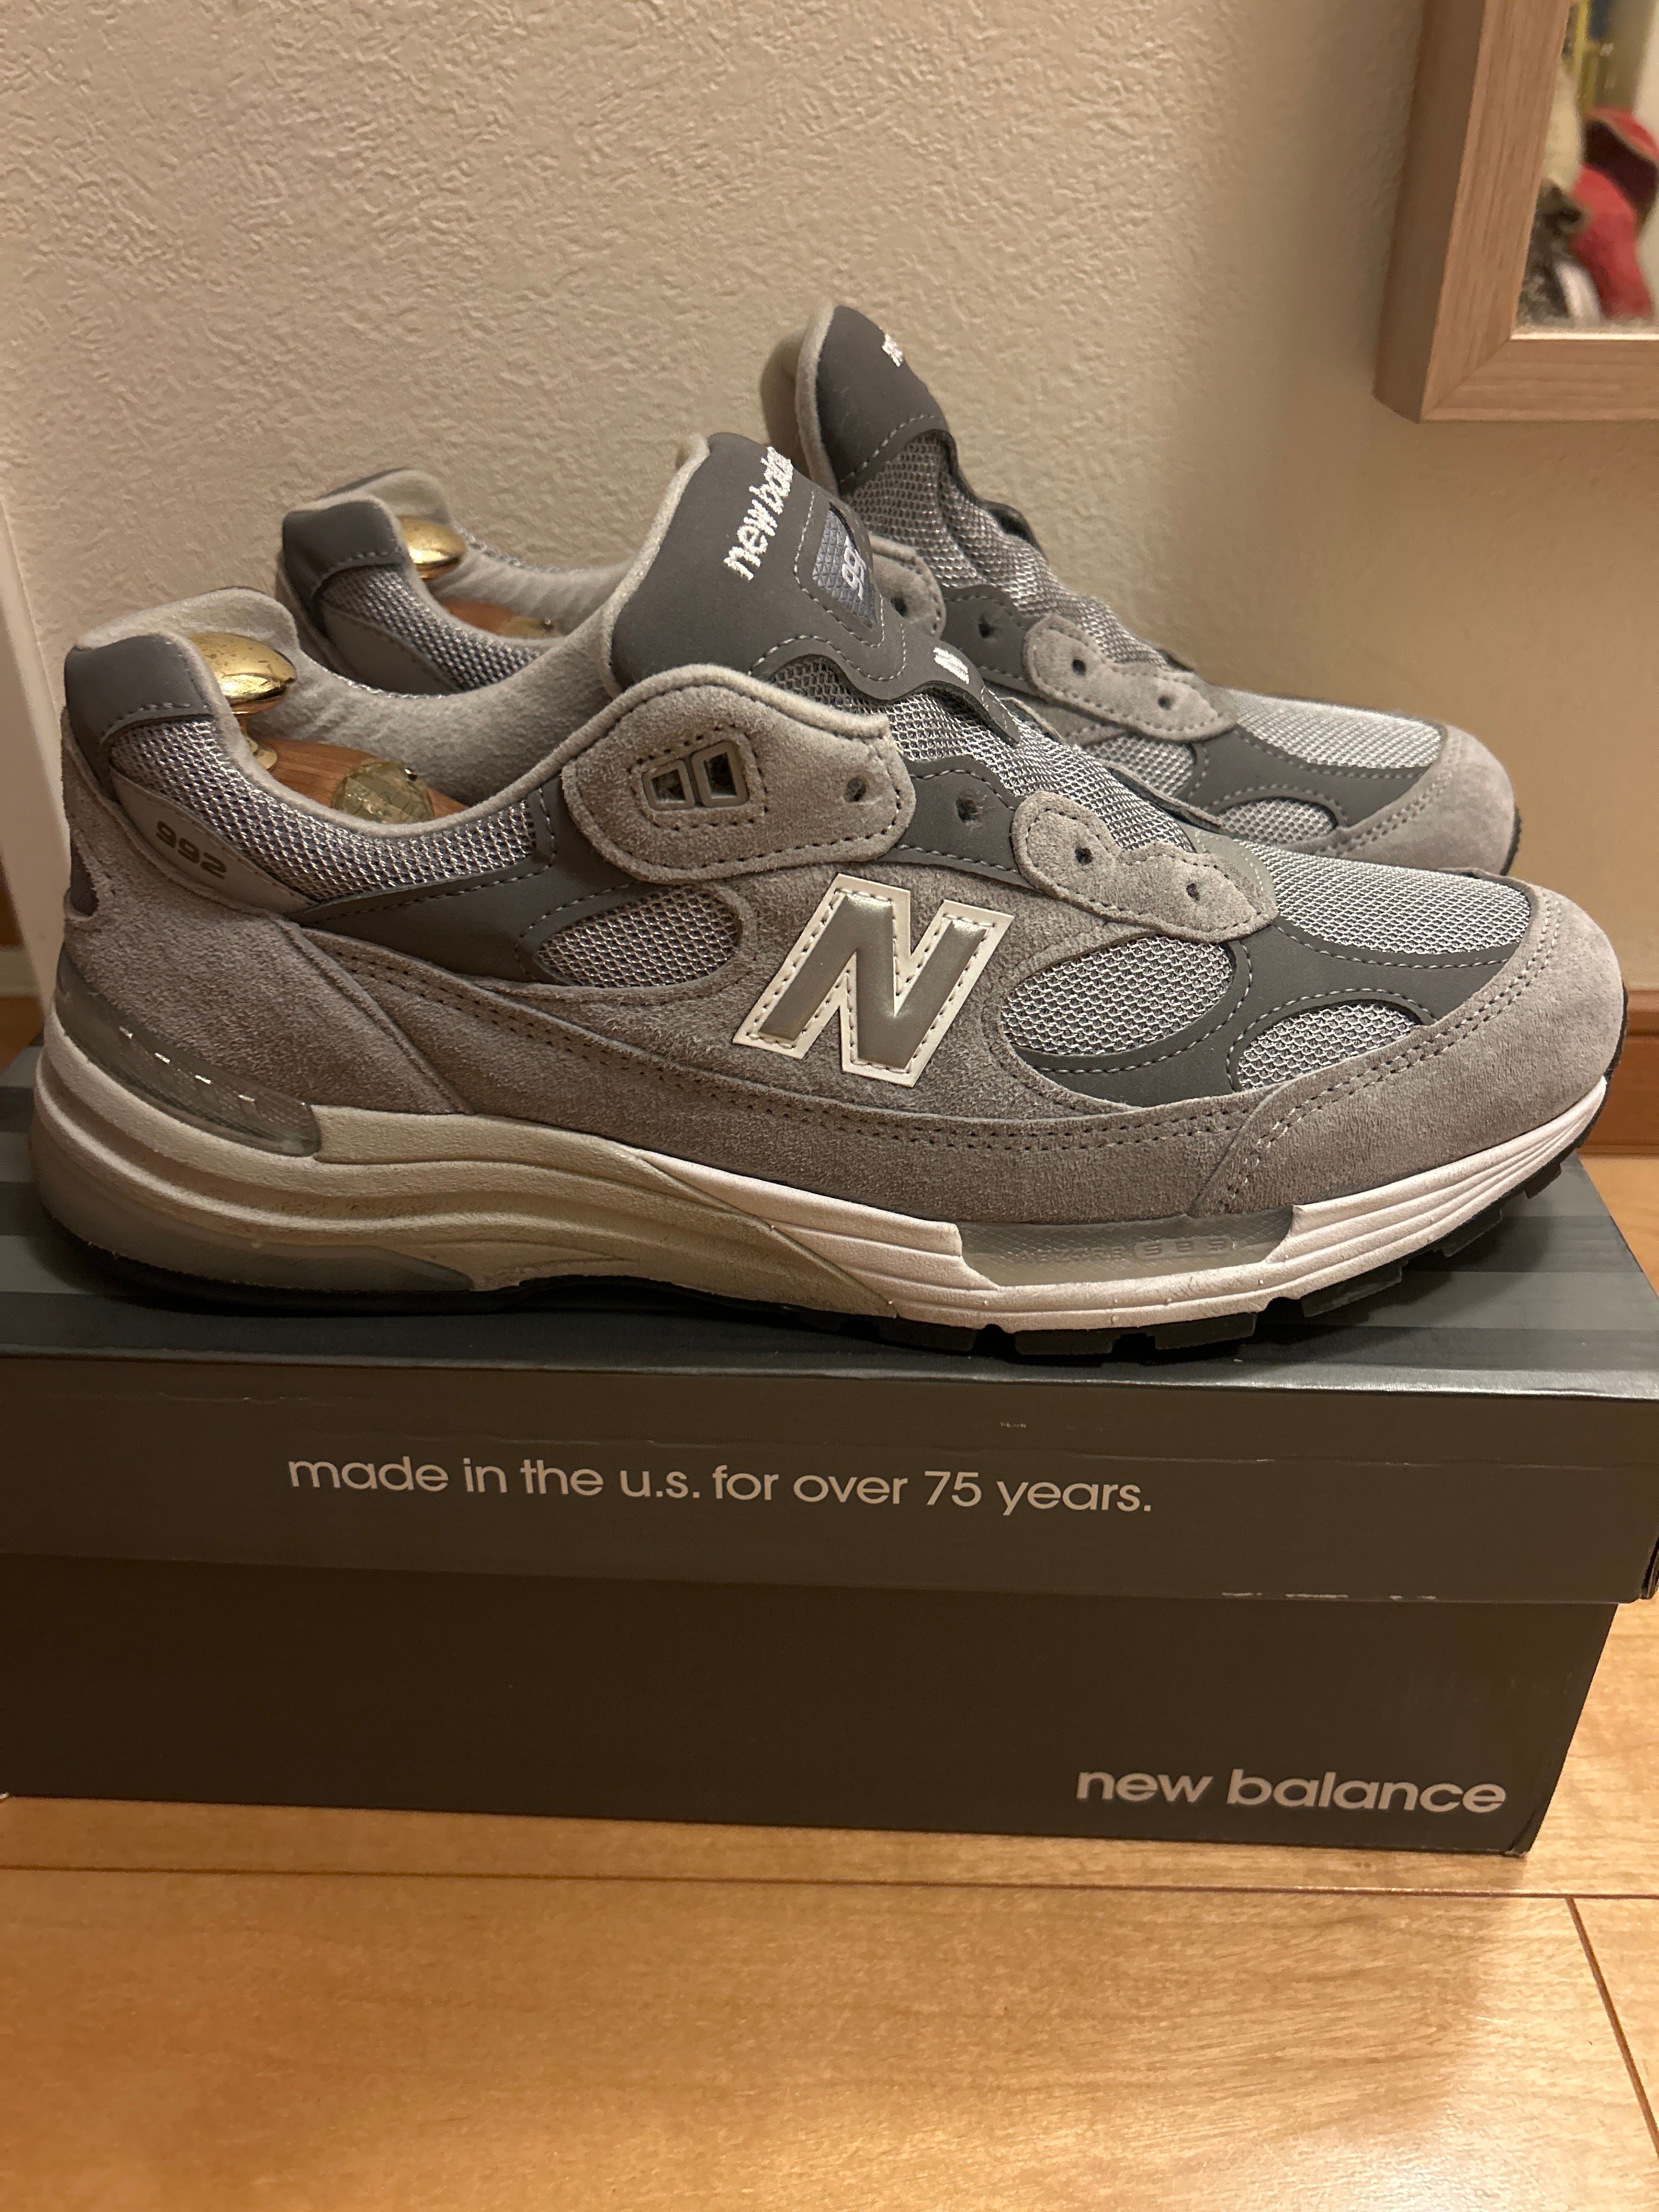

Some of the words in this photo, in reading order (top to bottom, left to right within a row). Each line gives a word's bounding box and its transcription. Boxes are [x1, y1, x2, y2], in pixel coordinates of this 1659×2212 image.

[748, 445, 794, 515] bala
[723, 499, 778, 581] new
[156, 821, 227, 879] 992
[732, 873, 1014, 1088] N
[287, 1455, 449, 1492] made
[462, 1457, 508, 1493] in
[520, 1459, 604, 1497] the
[619, 1470, 701, 1499] u.s.
[712, 1464, 780, 1500] for
[793, 1474, 909, 1505] over
[924, 1470, 982, 1508] 75
[996, 1481, 1152, 1516] years.
[1076, 1771, 1214, 1804] new
[1226, 1768, 1506, 1814] balance
